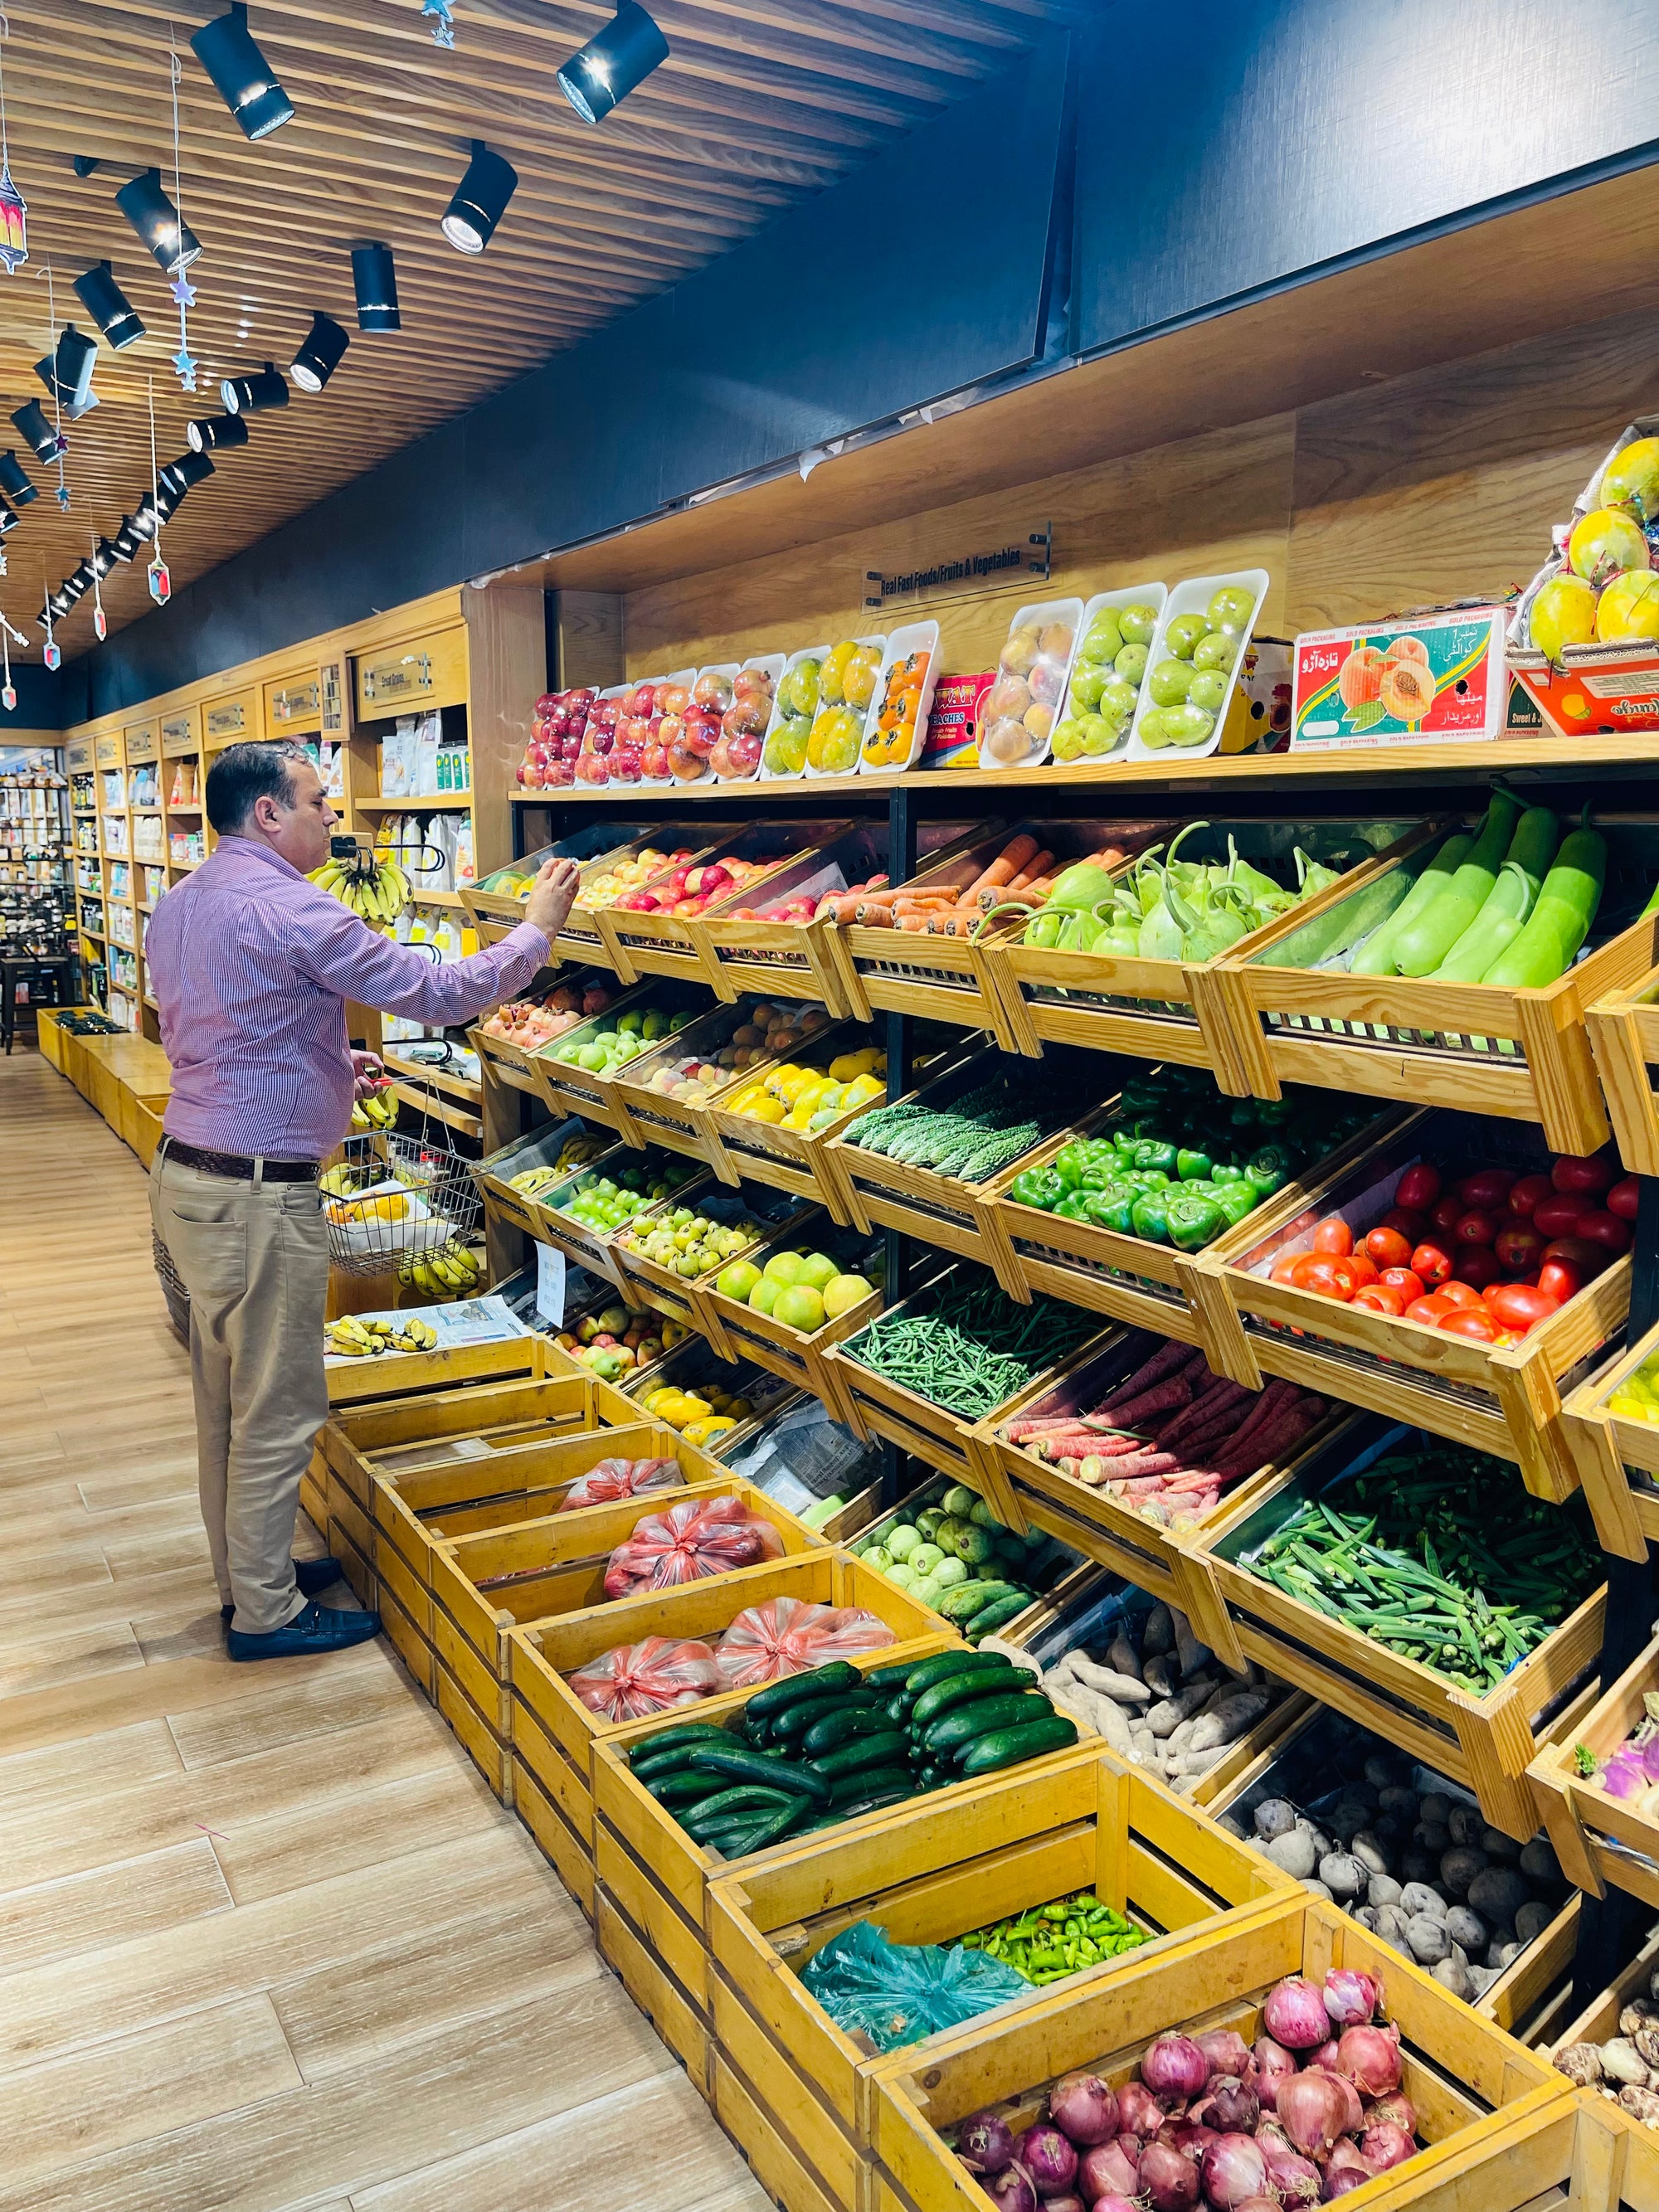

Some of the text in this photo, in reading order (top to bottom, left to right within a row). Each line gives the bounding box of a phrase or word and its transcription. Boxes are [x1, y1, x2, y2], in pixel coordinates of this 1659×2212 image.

[881, 547, 1020, 596] Real Fast Foods/Fruits & Vegetables
[1612, 698, 1659, 716] ango
[1512, 712, 1530, 723] Sweet
[1532, 712, 1536, 723] &
